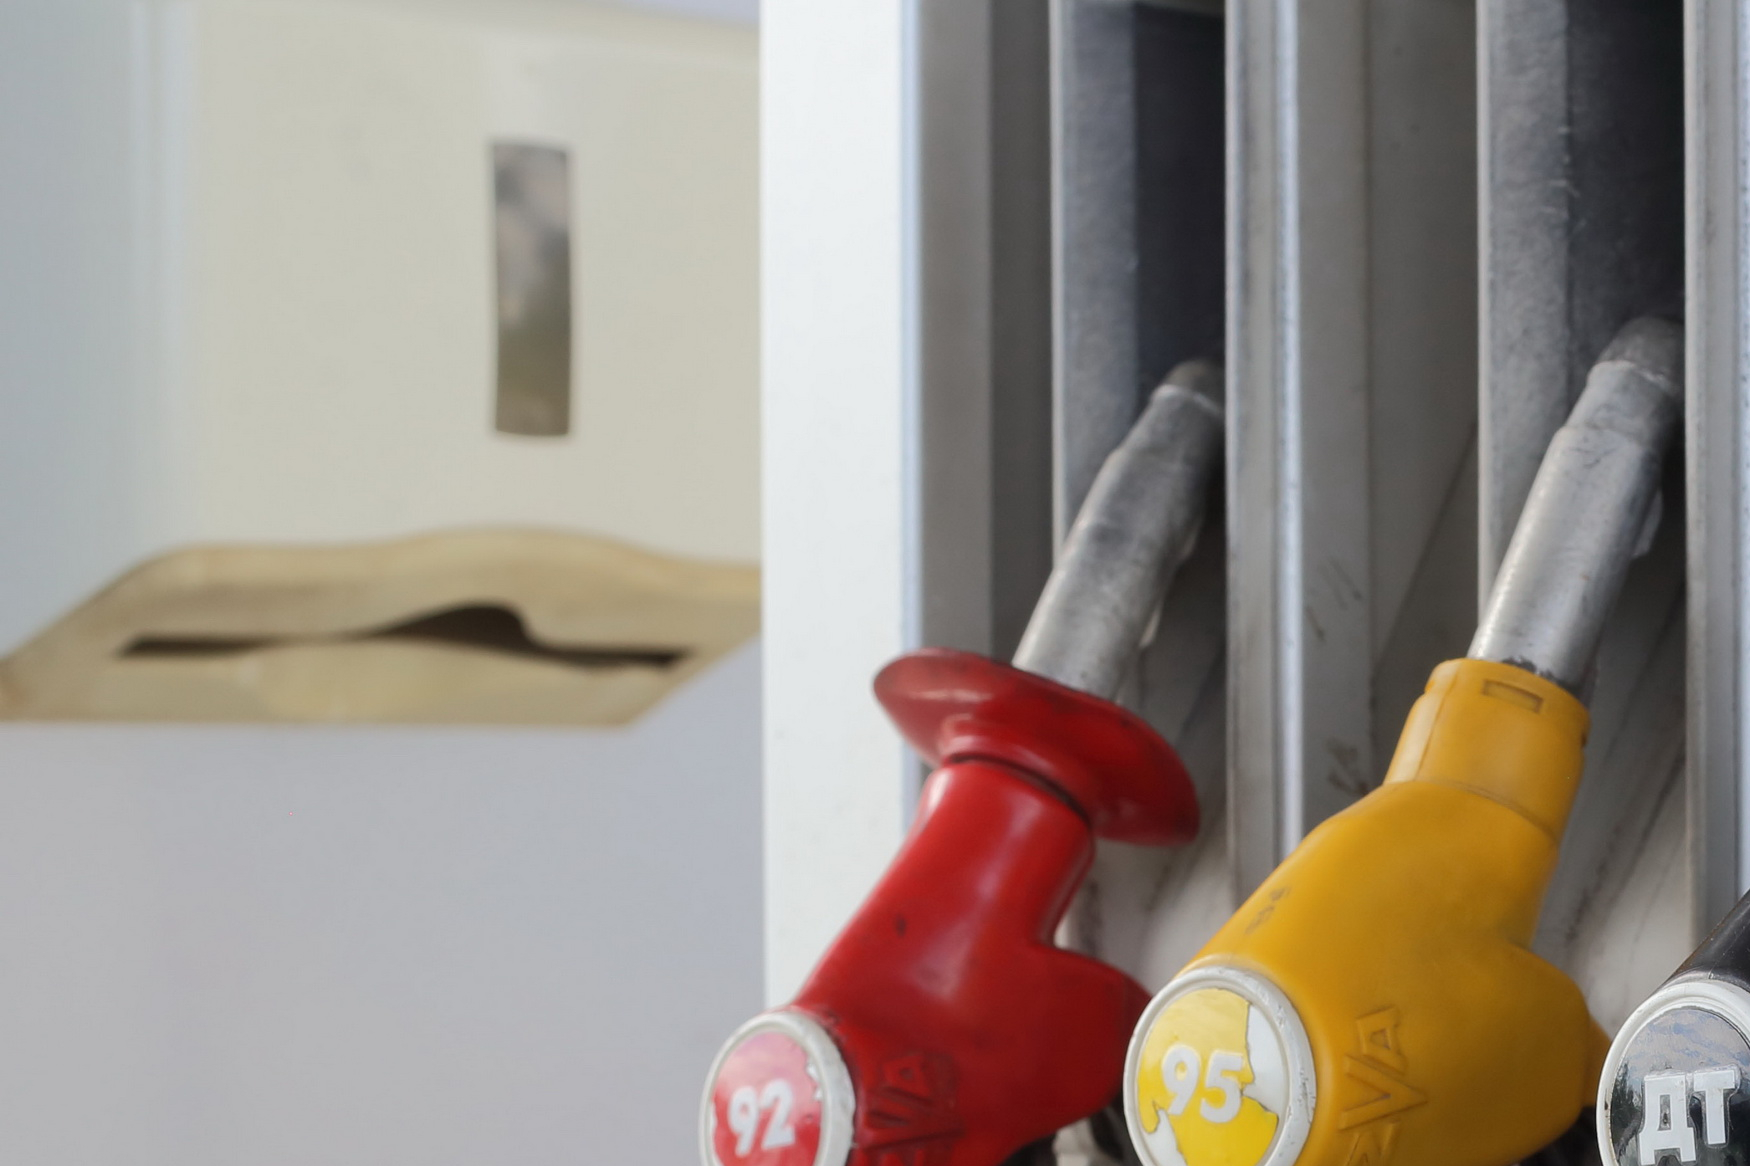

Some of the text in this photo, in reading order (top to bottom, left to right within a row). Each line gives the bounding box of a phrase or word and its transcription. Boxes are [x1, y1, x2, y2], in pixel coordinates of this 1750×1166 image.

[727, 1077, 796, 1157] 92
[1161, 1044, 1244, 1123] 95
[1638, 1067, 1738, 1166] ДТ
